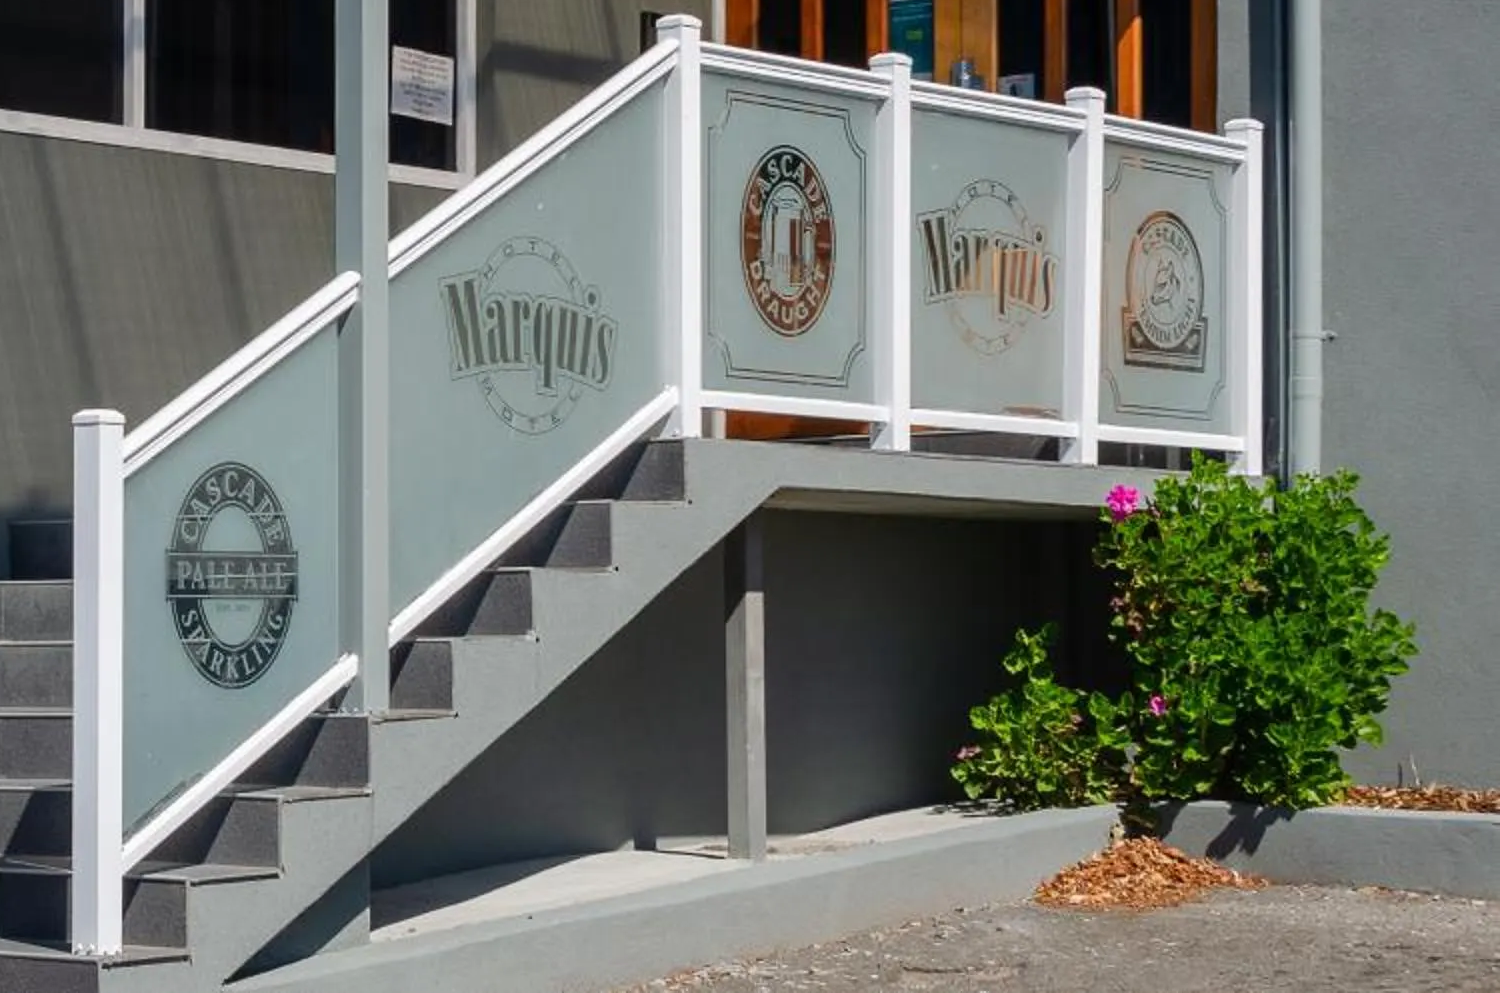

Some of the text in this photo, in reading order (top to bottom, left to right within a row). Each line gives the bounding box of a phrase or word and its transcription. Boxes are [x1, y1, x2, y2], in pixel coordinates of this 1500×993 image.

[749, 154, 828, 223] CASCADE
[750, 260, 827, 325] DRAUGHT
[921, 215, 1057, 315] Marquis
[443, 278, 615, 390] Marquis
[181, 470, 286, 547] CASCADE
[176, 559, 289, 590] PALE ALE
[181, 607, 285, 680] SPARKLING
